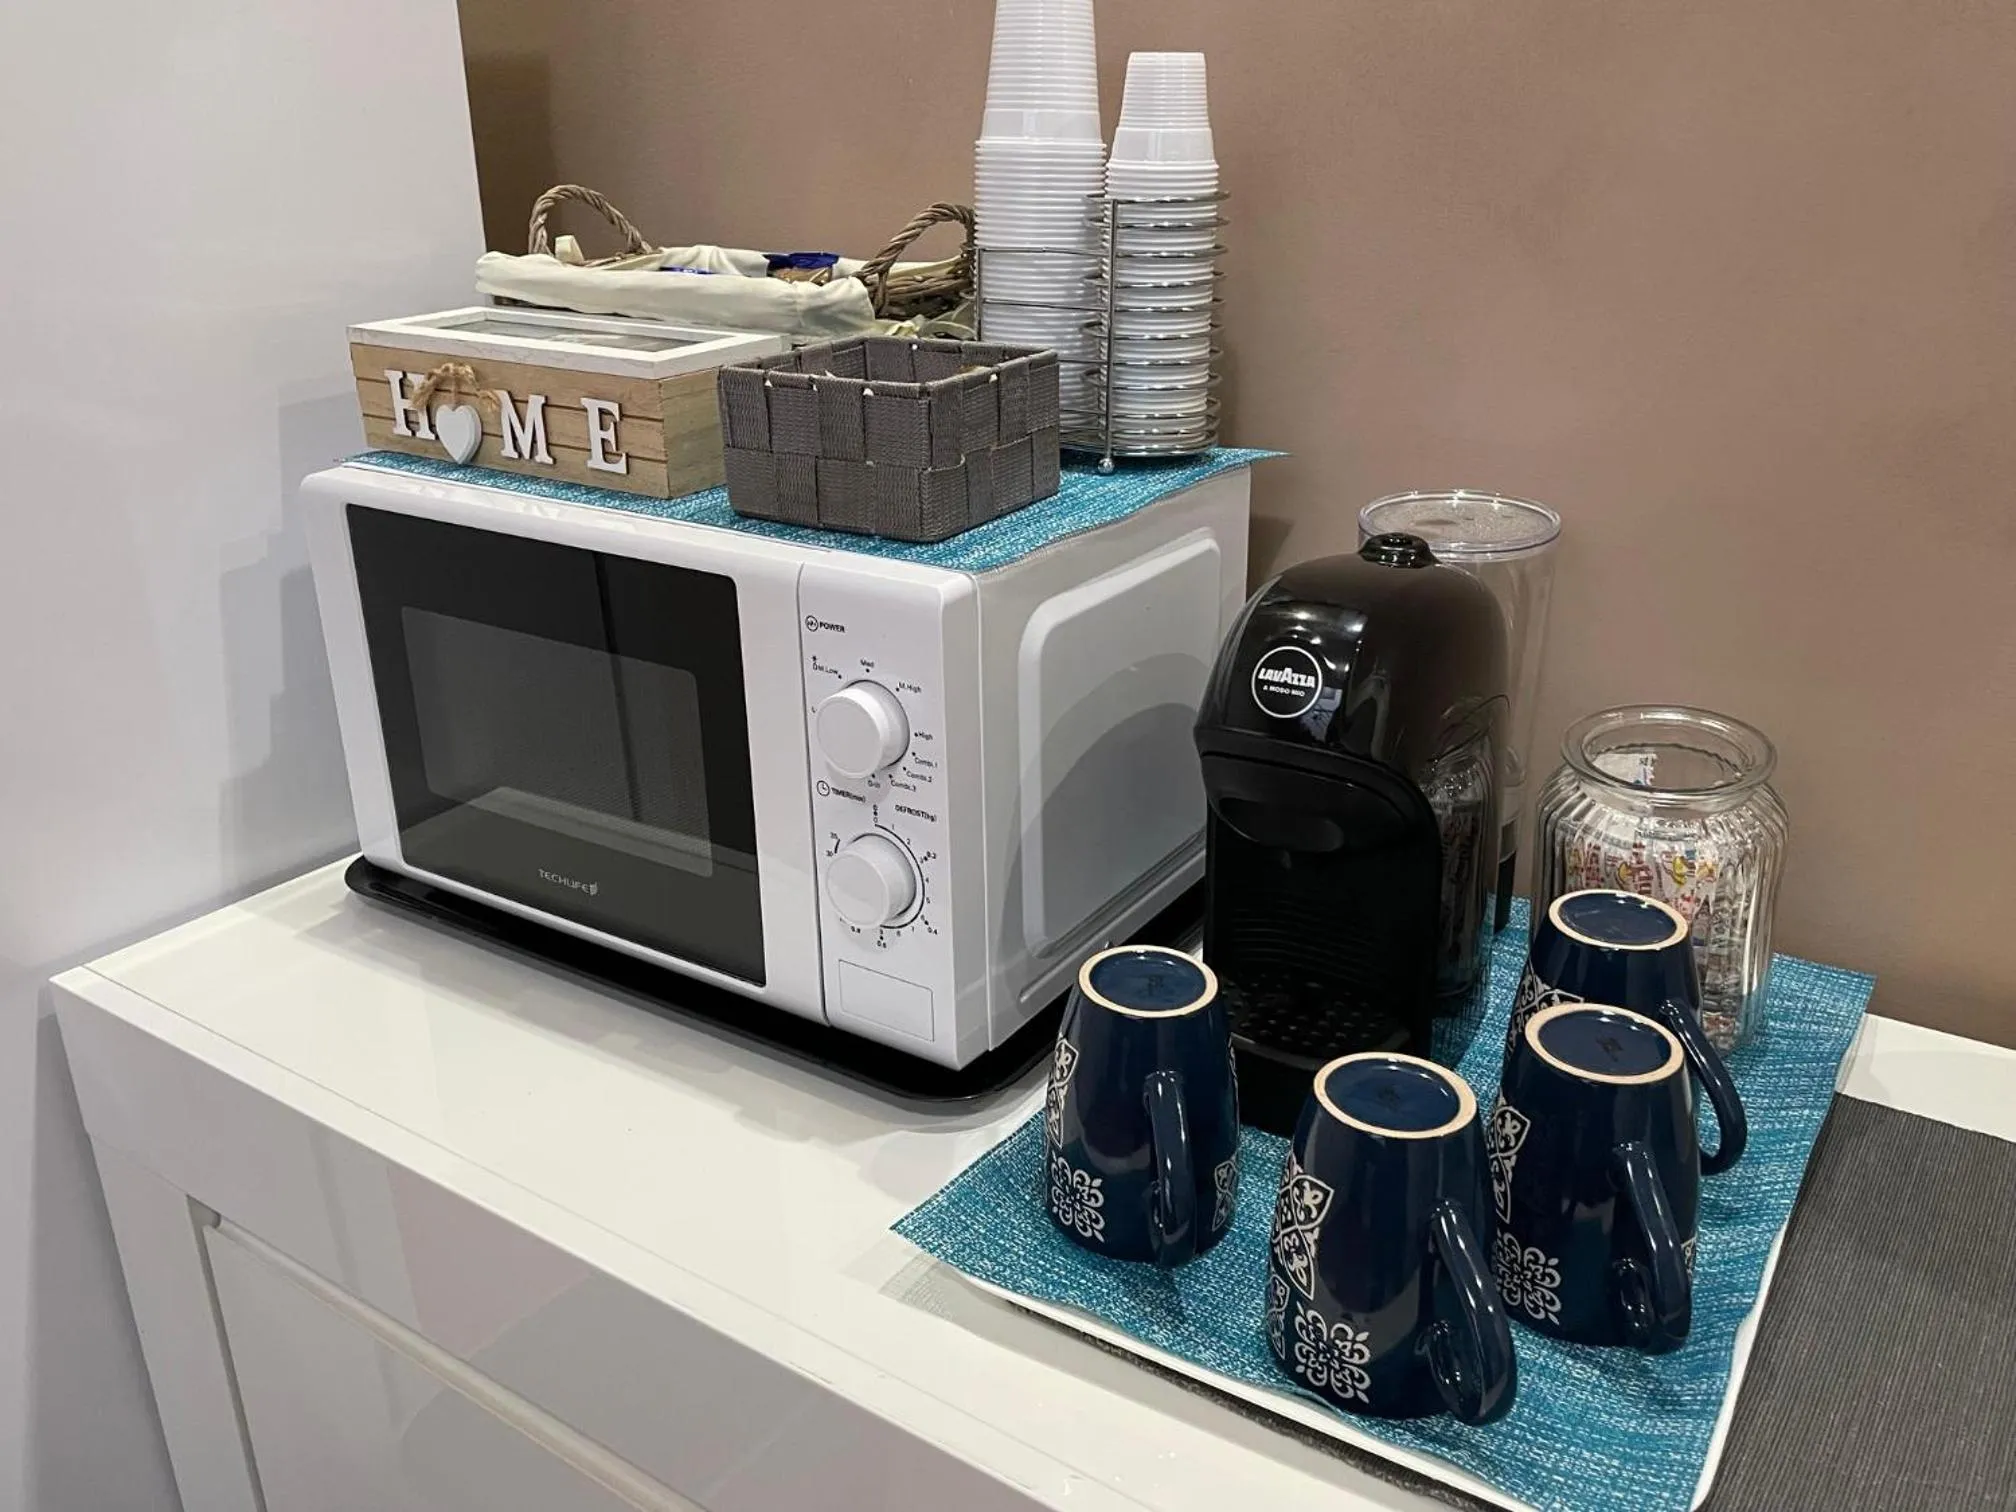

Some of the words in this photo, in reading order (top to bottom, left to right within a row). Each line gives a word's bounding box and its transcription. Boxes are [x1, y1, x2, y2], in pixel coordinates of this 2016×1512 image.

[819, 621, 846, 633] POWER
[1258, 667, 1316, 688] LAVAZZA
[1269, 685, 1291, 694] MODO
[1291, 689, 1306, 697] MIO
